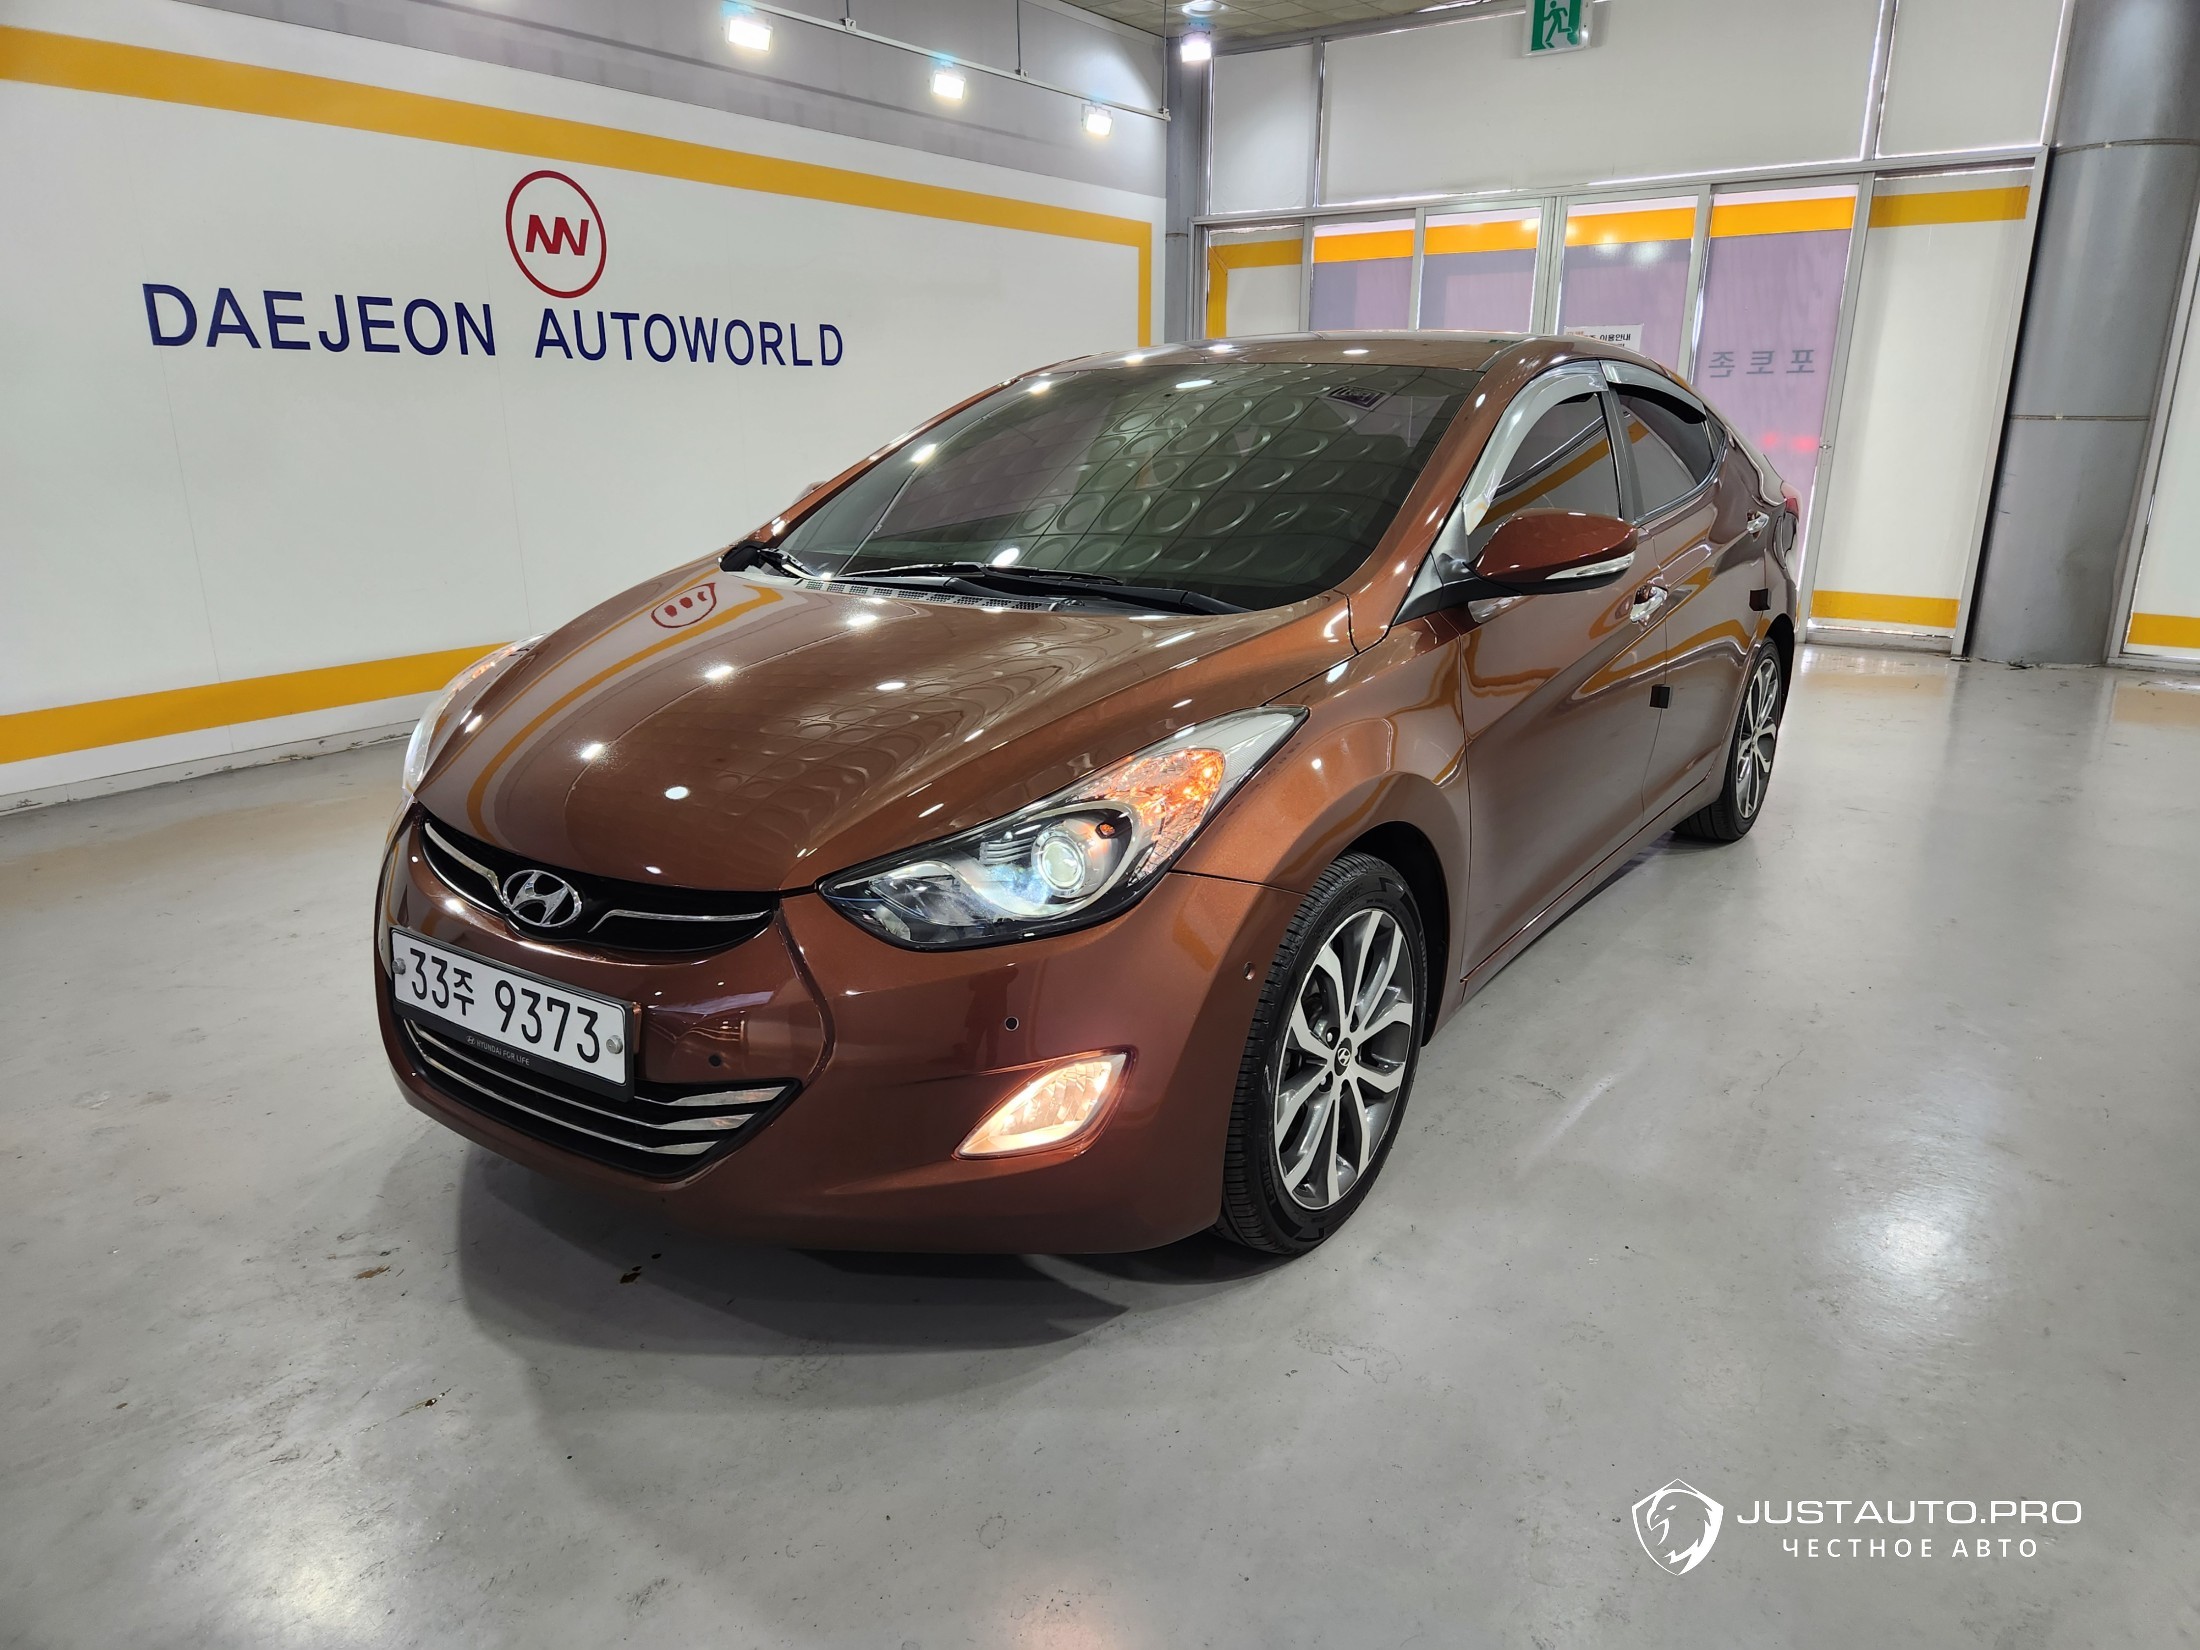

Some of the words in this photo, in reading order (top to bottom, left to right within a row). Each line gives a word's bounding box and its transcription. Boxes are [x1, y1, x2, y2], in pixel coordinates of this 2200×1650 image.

[142, 282, 496, 357] DAEJEON
[533, 308, 845, 367] AUTOWORLD
[410, 947, 475, 1016] 33주
[494, 979, 600, 1064] 9373
[502, 1050, 516, 1061] FOR
[516, 1054, 530, 1066] LIFE
